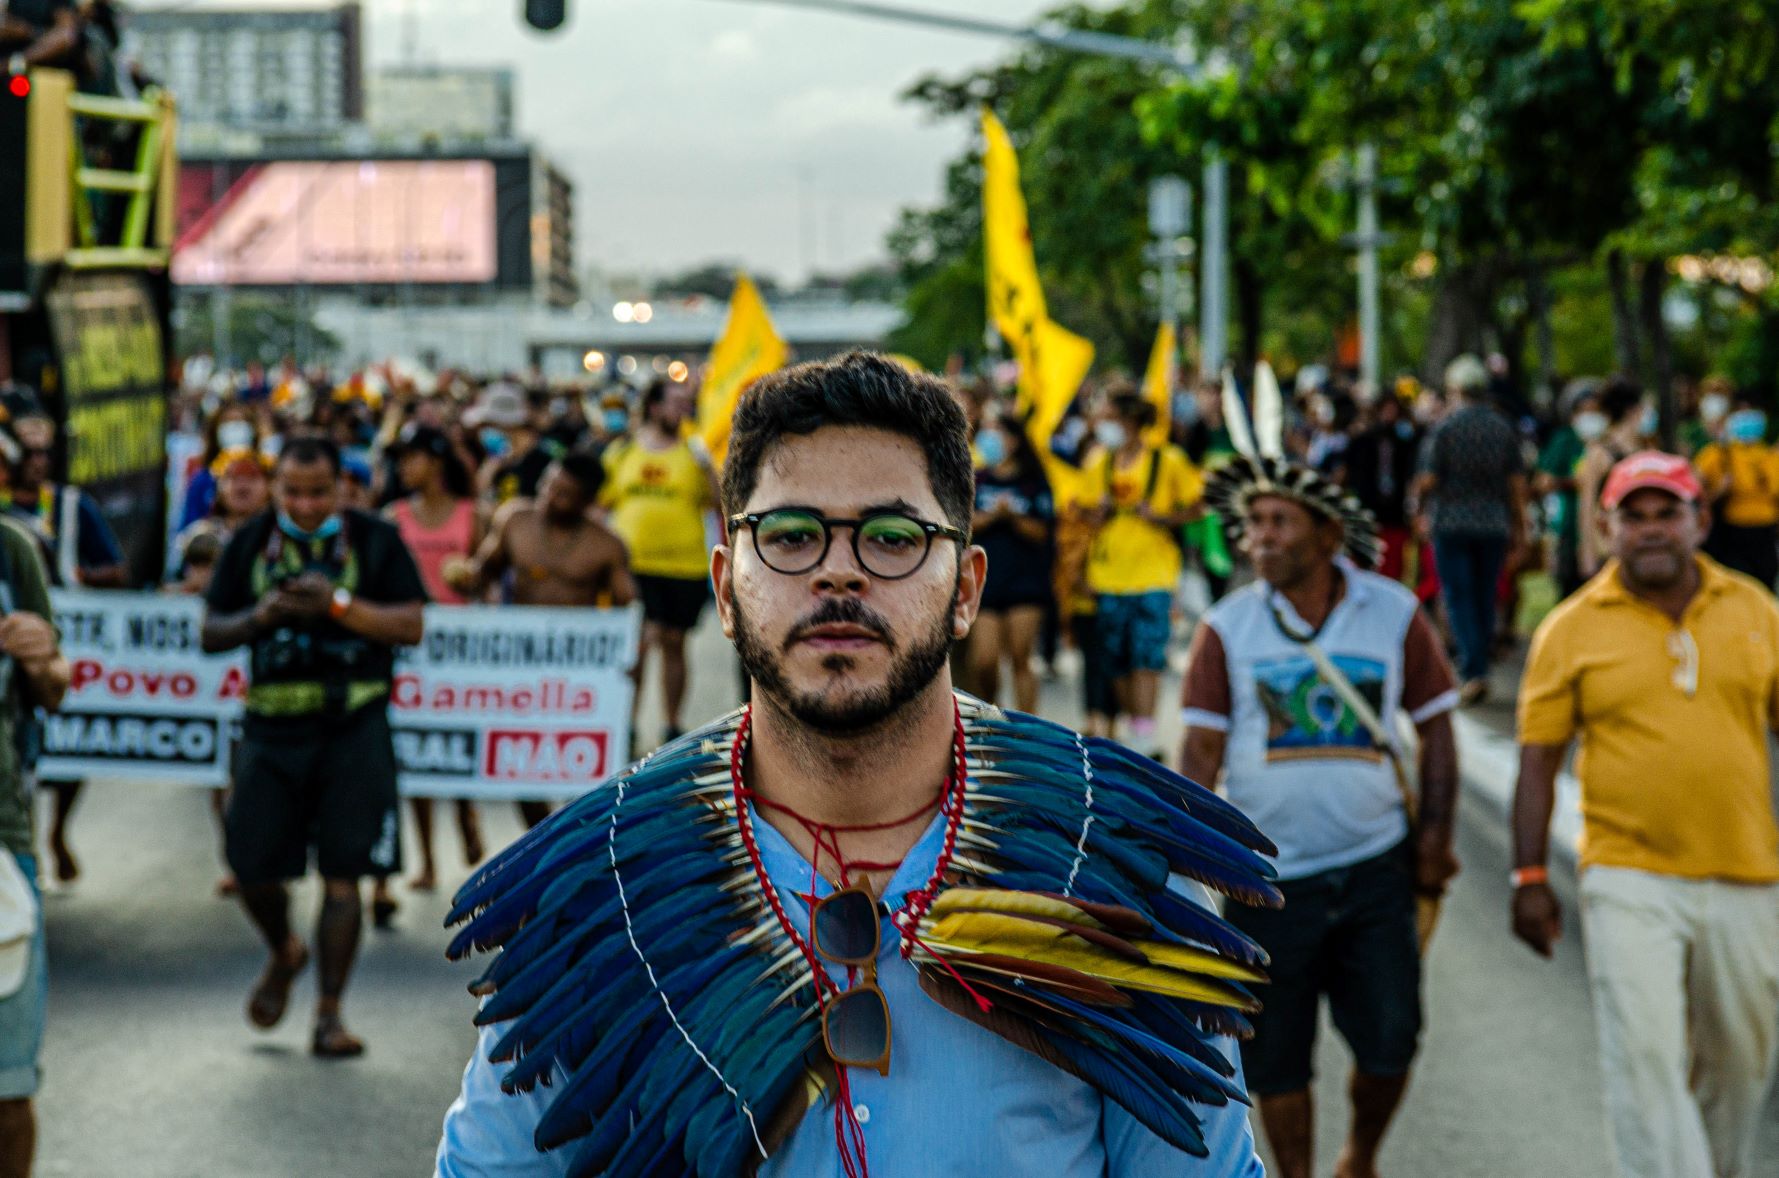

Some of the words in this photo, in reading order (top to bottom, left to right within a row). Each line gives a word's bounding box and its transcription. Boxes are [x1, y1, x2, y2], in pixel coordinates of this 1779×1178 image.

[69, 659, 196, 699] Povo
[391, 673, 595, 711] Gamella
[46, 715, 214, 760] MARCO
